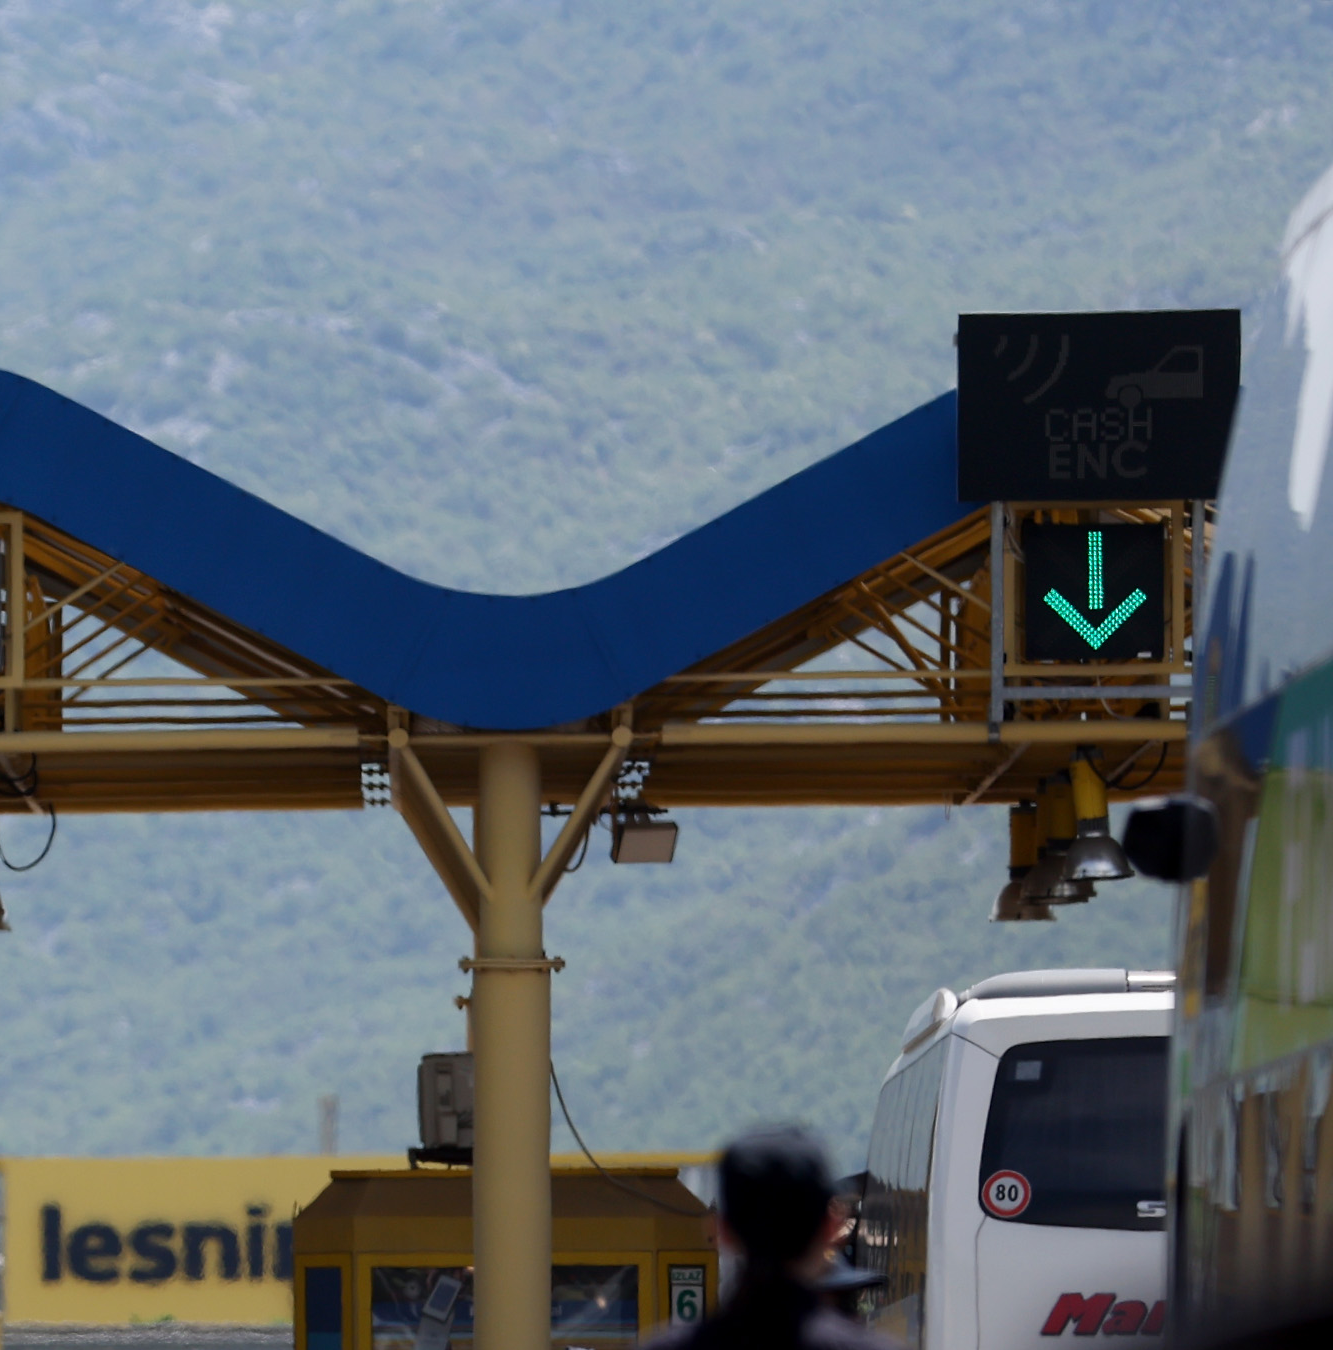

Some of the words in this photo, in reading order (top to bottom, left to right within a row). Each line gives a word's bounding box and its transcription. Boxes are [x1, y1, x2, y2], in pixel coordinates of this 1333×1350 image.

[1044, 406, 1153, 441] CASH
[1048, 442, 1148, 480] ENC
[996, 1184, 1018, 1202] 80
[677, 1289, 698, 1324] 6
